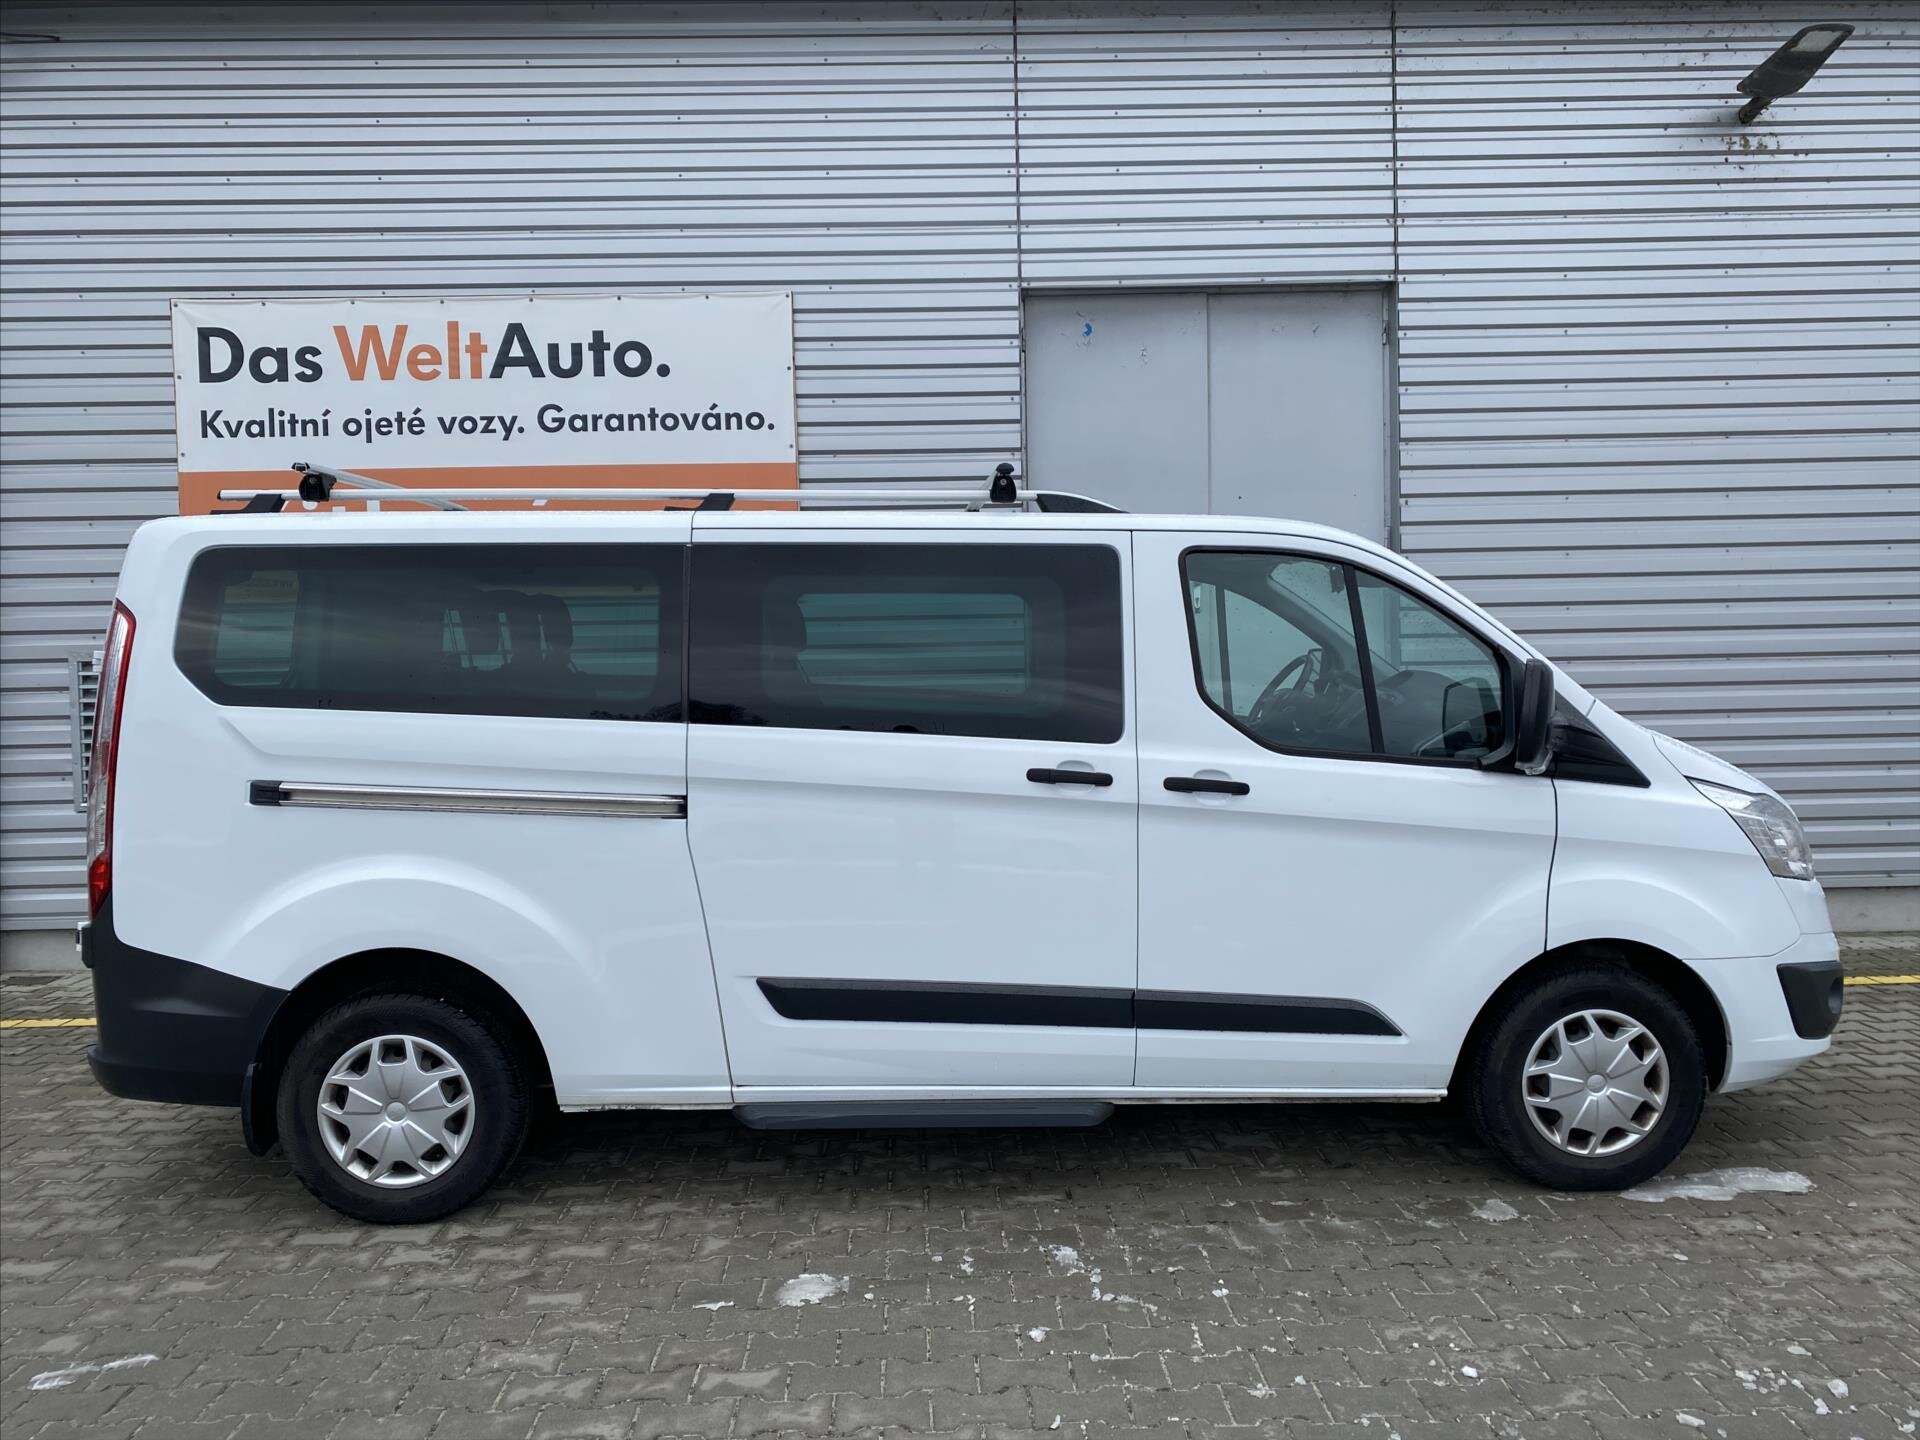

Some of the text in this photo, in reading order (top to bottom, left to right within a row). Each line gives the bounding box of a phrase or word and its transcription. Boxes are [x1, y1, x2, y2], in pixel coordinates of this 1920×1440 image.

[196, 320, 672, 385] Das WeltAuto.
[199, 402, 776, 445] Kvalitní ojeté vozy. Garantováno.
